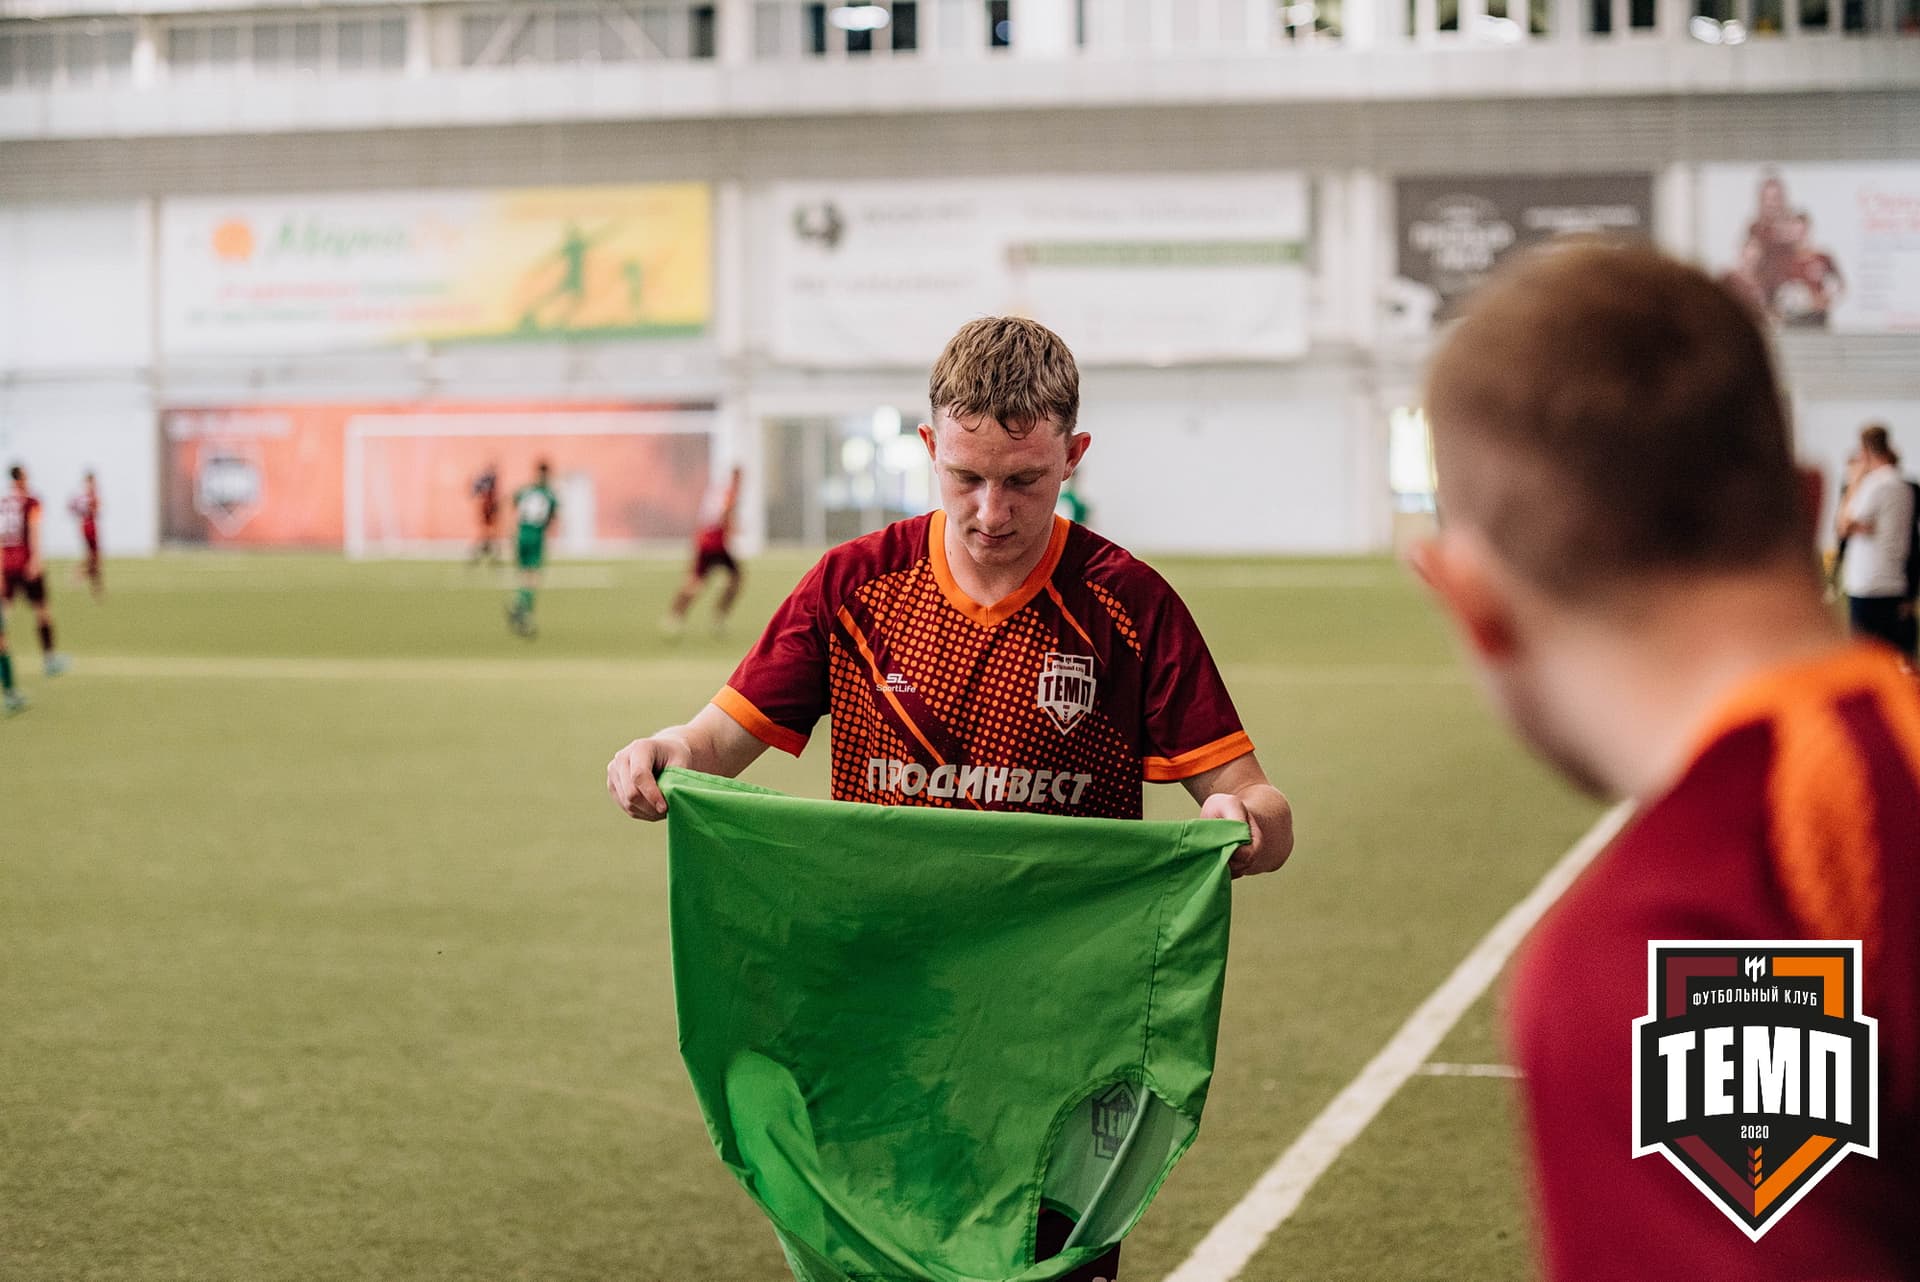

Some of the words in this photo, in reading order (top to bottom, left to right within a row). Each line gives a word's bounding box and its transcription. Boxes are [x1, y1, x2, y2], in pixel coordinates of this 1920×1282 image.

[876, 684, 917, 693] SportLife
[886, 673, 908, 684] SL
[1043, 675, 1092, 708] ТЕМП
[868, 757, 1092, 805] ПРОДИНВЕСТ
